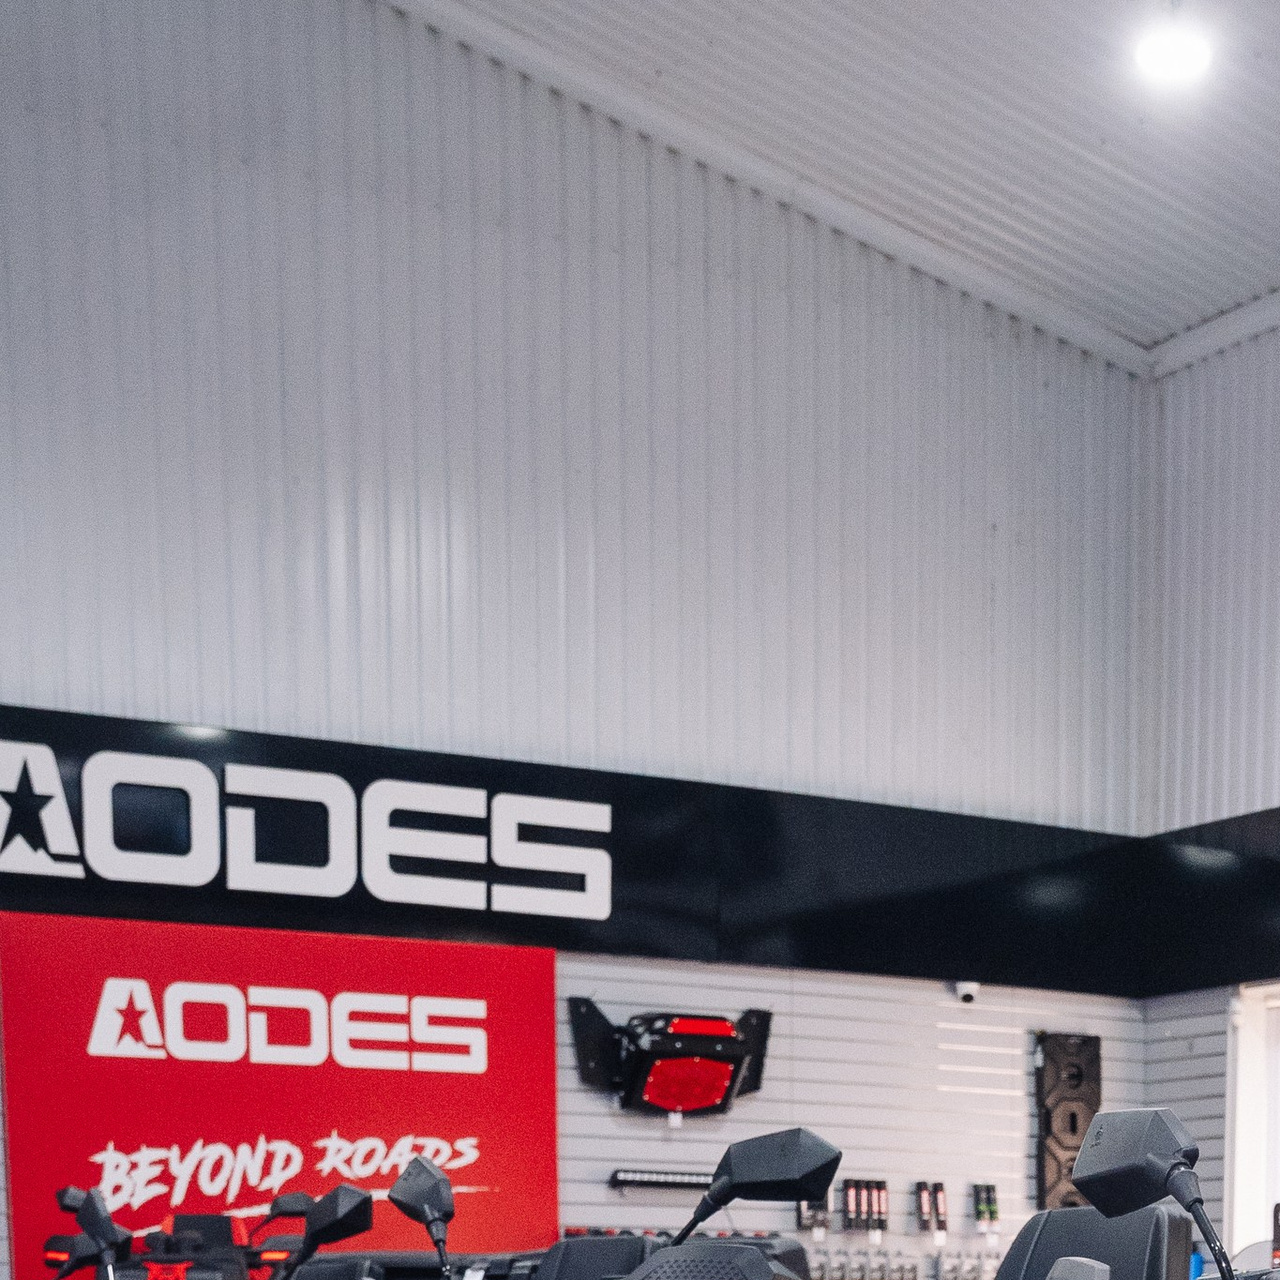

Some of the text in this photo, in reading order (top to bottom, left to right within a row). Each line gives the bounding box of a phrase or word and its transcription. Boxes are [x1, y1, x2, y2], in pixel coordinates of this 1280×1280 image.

[0, 739, 612, 921] AODES
[88, 977, 488, 1074] AODES
[89, 1133, 303, 1214] BEYOND
